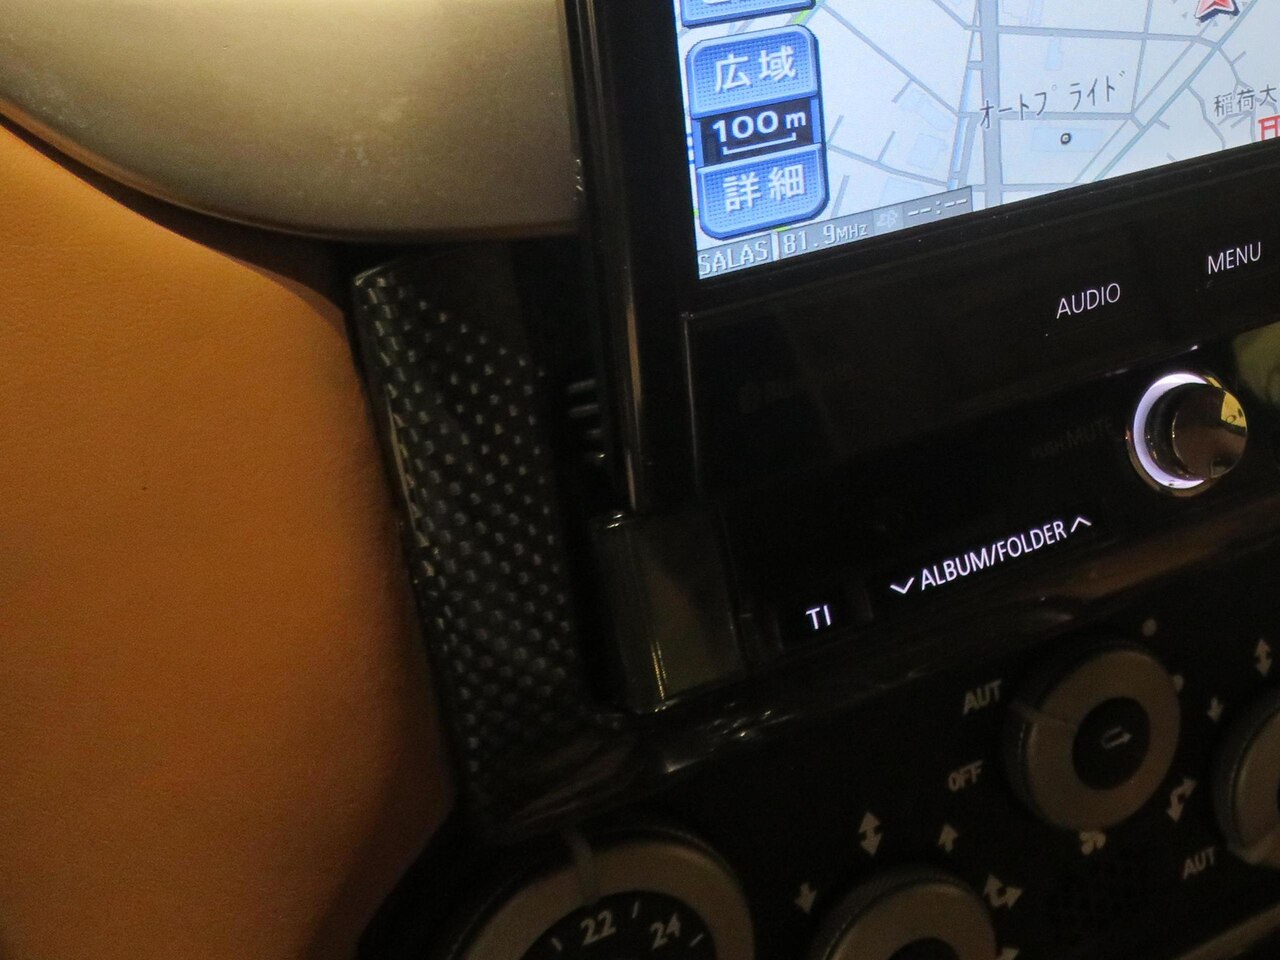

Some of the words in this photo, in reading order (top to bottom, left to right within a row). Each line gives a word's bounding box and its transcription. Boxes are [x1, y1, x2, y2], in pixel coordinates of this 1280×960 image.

[713, 44, 798, 93] 広域
[712, 110, 778, 144] 100
[785, 113, 807, 131] m
[722, 163, 806, 213] 詳細
[1207, 241, 1262, 274] MENU
[1056, 282, 1121, 319] AUDIO
[920, 520, 1067, 591] ALBUM/FOLDER
[806, 605, 832, 630] TI
[961, 678, 1002, 716] AUT
[947, 759, 984, 792] OFF
[1182, 845, 1217, 881] AUT
[580, 910, 616, 946] 22
[650, 912, 681, 950] 24
